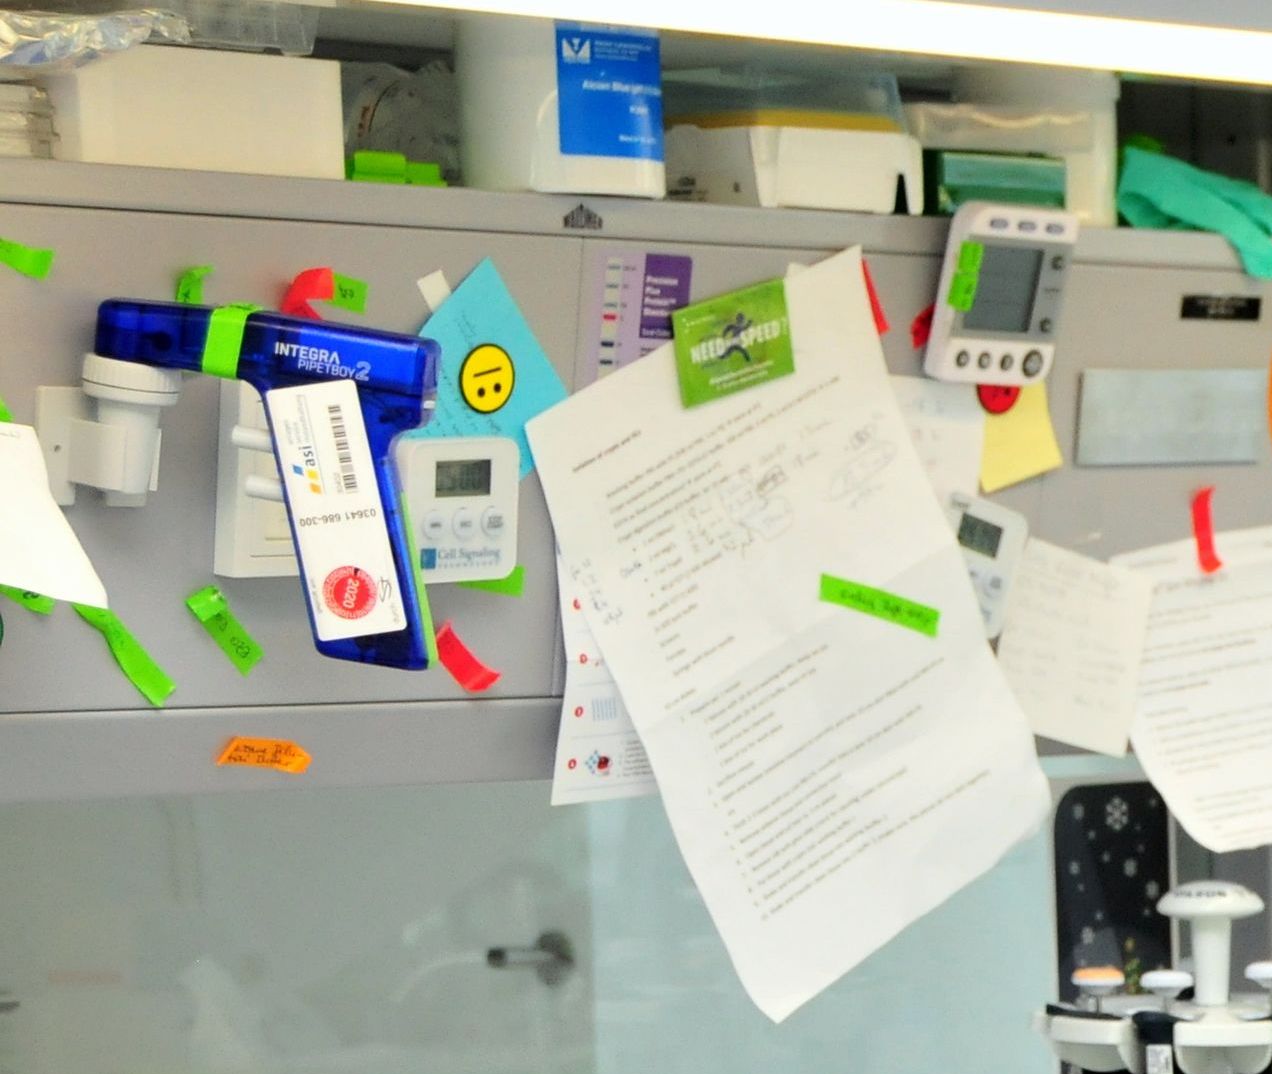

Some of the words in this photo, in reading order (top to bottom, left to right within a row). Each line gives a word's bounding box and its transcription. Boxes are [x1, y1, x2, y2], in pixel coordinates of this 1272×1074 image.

[275, 342, 340, 365] INTEGRA
[297, 358, 356, 379] PIPETBOY
[355, 361, 372, 382] 2
[343, 579, 360, 609] 2020
